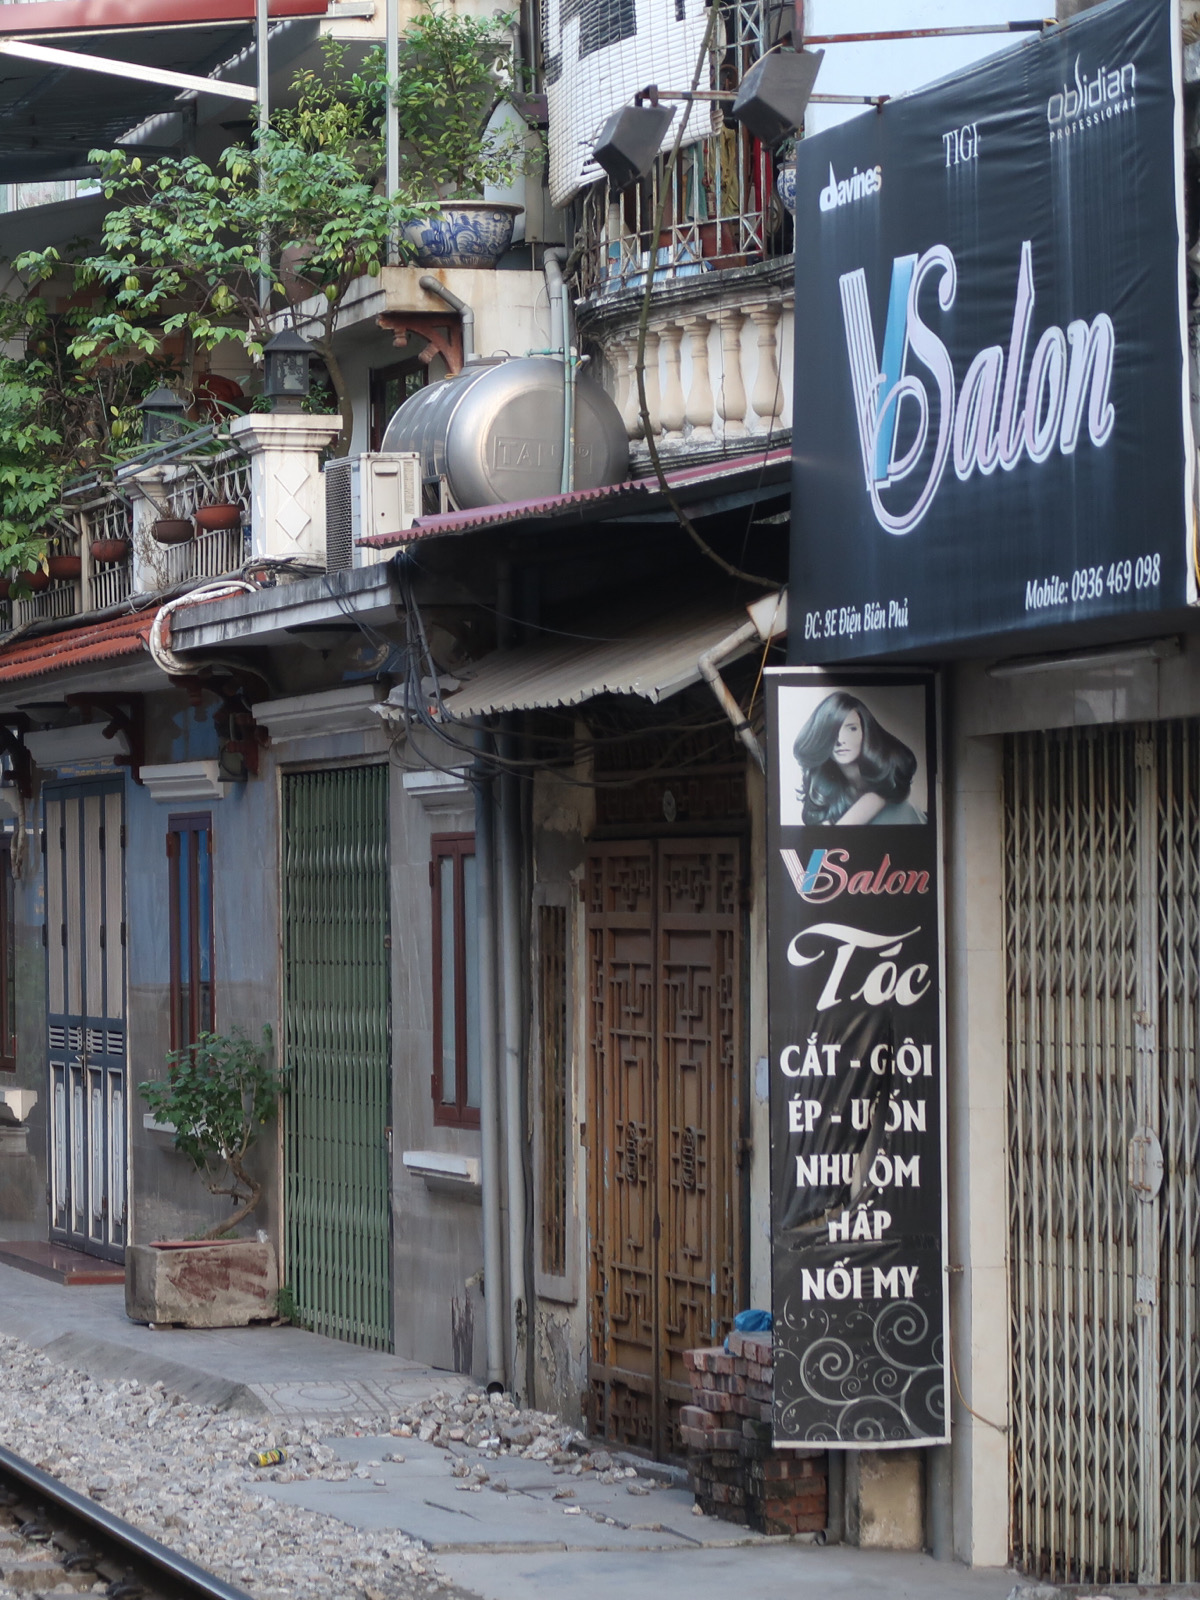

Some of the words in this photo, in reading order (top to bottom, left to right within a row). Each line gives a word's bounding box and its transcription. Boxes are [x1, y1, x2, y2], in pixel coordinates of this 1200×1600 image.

[1050, 96, 1135, 142] PROFESSIONAL
[942, 122, 979, 167] TIGI
[820, 161, 882, 212] davines
[1025, 575, 1068, 611] Mobile:
[1071, 565, 1104, 602] 0936
[1106, 559, 1132, 594] 469
[1135, 553, 1160, 589] 098
[805, 611, 822, 640] ĐC:
[839, 605, 861, 639] Điện
[864, 602, 886, 631] Biên
[888, 598, 908, 628] Phủ
[787, 922, 931, 1012] Tóc
[780, 1032, 841, 1077] CẮT
[789, 1093, 822, 1132] ÉP
[828, 1200, 892, 1242] HẤP
[801, 1257, 862, 1300] NỐI
[872, 1266, 919, 1298] MY
